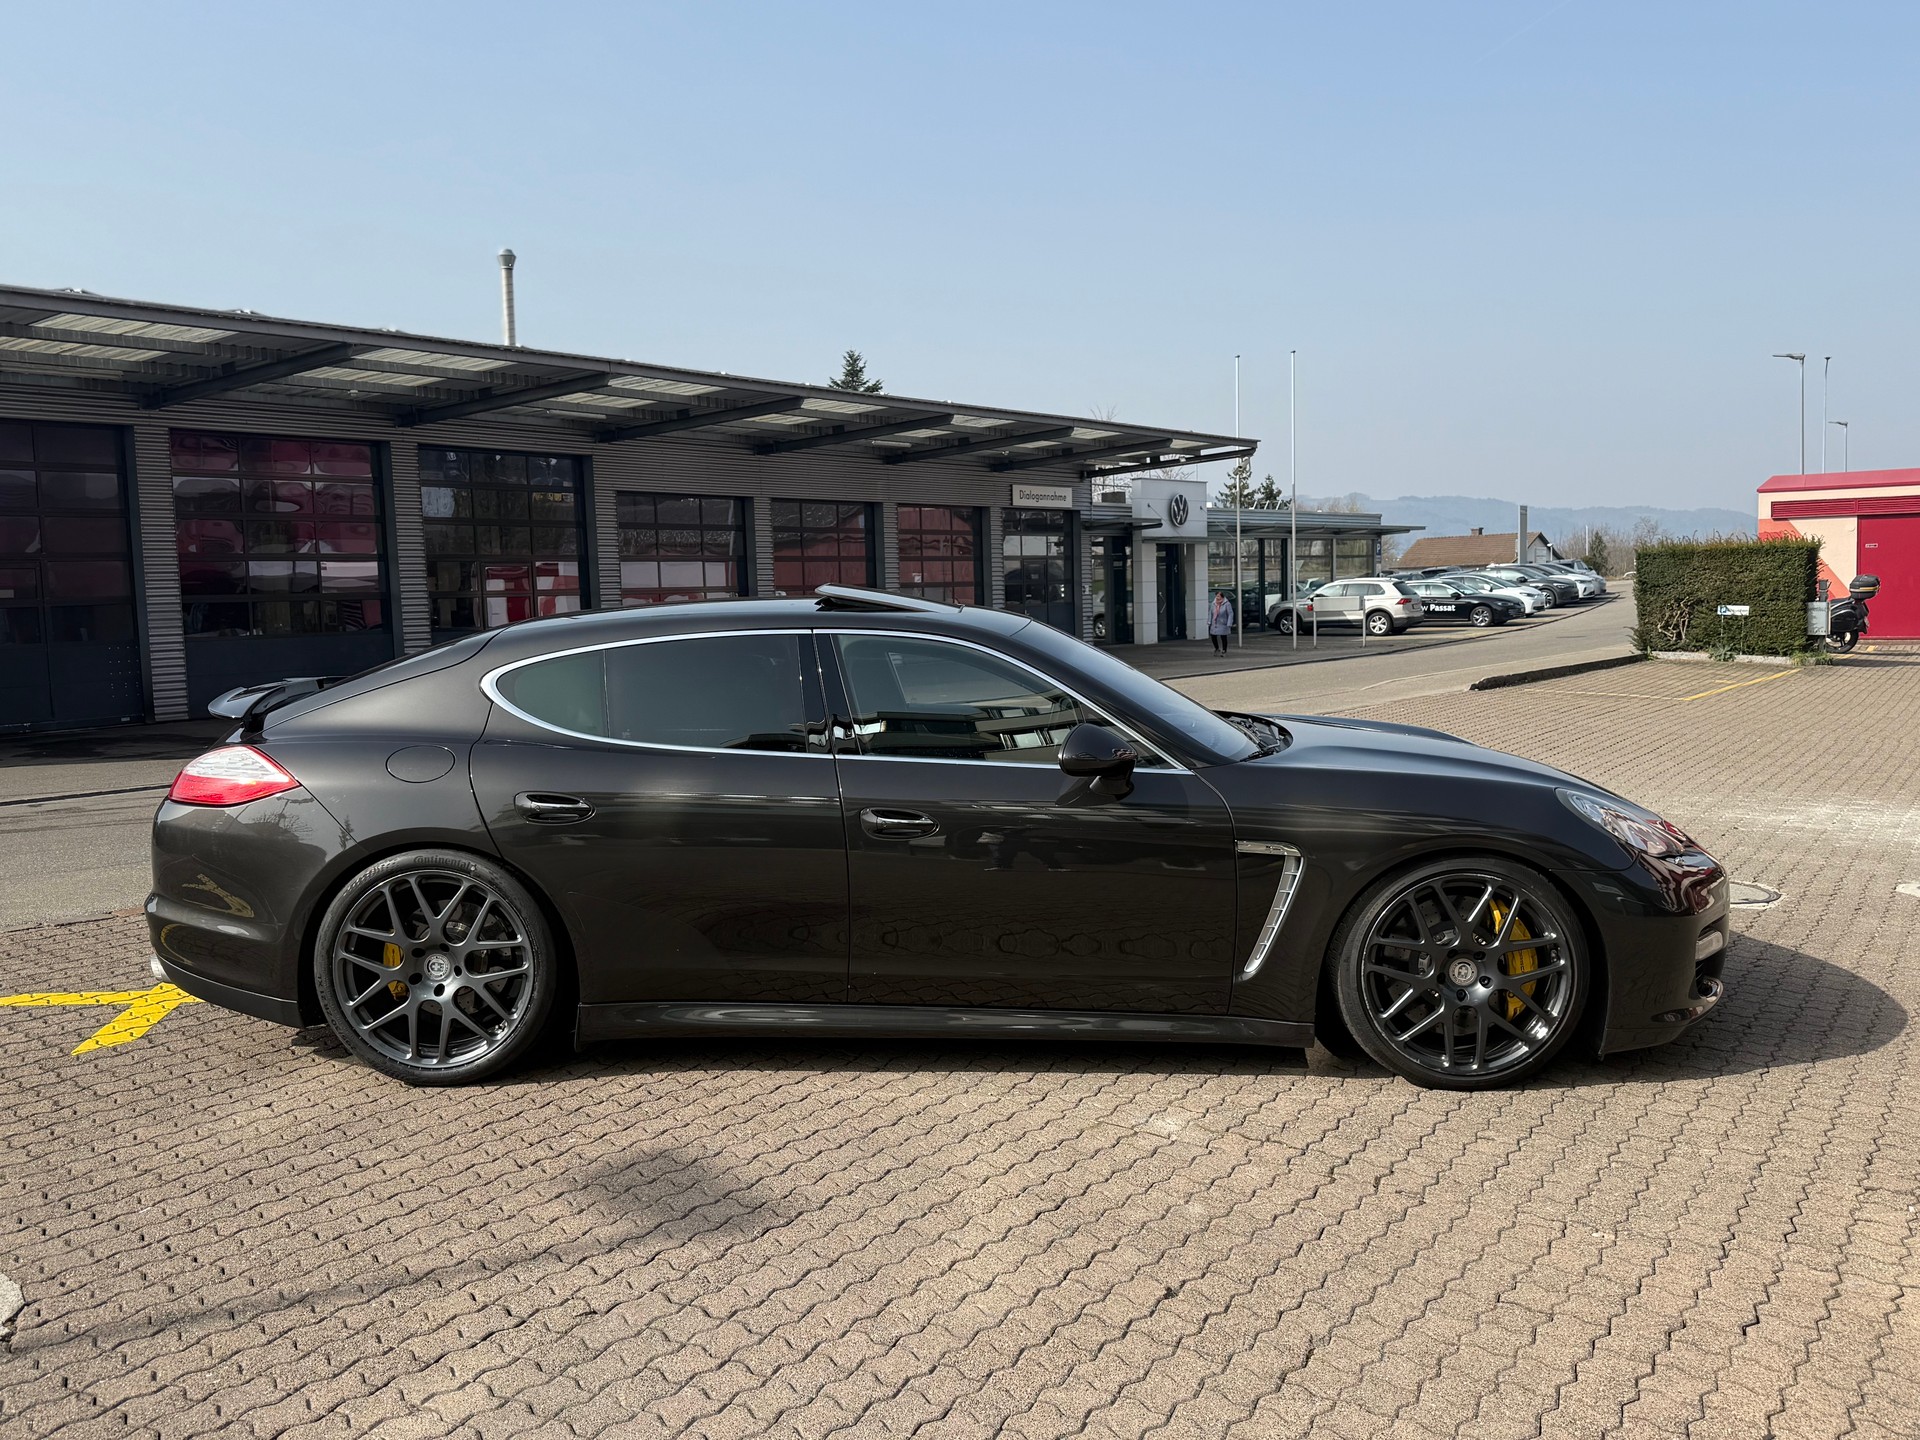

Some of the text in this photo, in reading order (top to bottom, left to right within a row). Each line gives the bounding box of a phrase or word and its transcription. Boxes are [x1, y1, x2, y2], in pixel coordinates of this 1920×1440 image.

[1019, 489, 1067, 503] Dialogannahme
[1430, 603, 1456, 612] Passat
[414, 855, 471, 870] Continental
